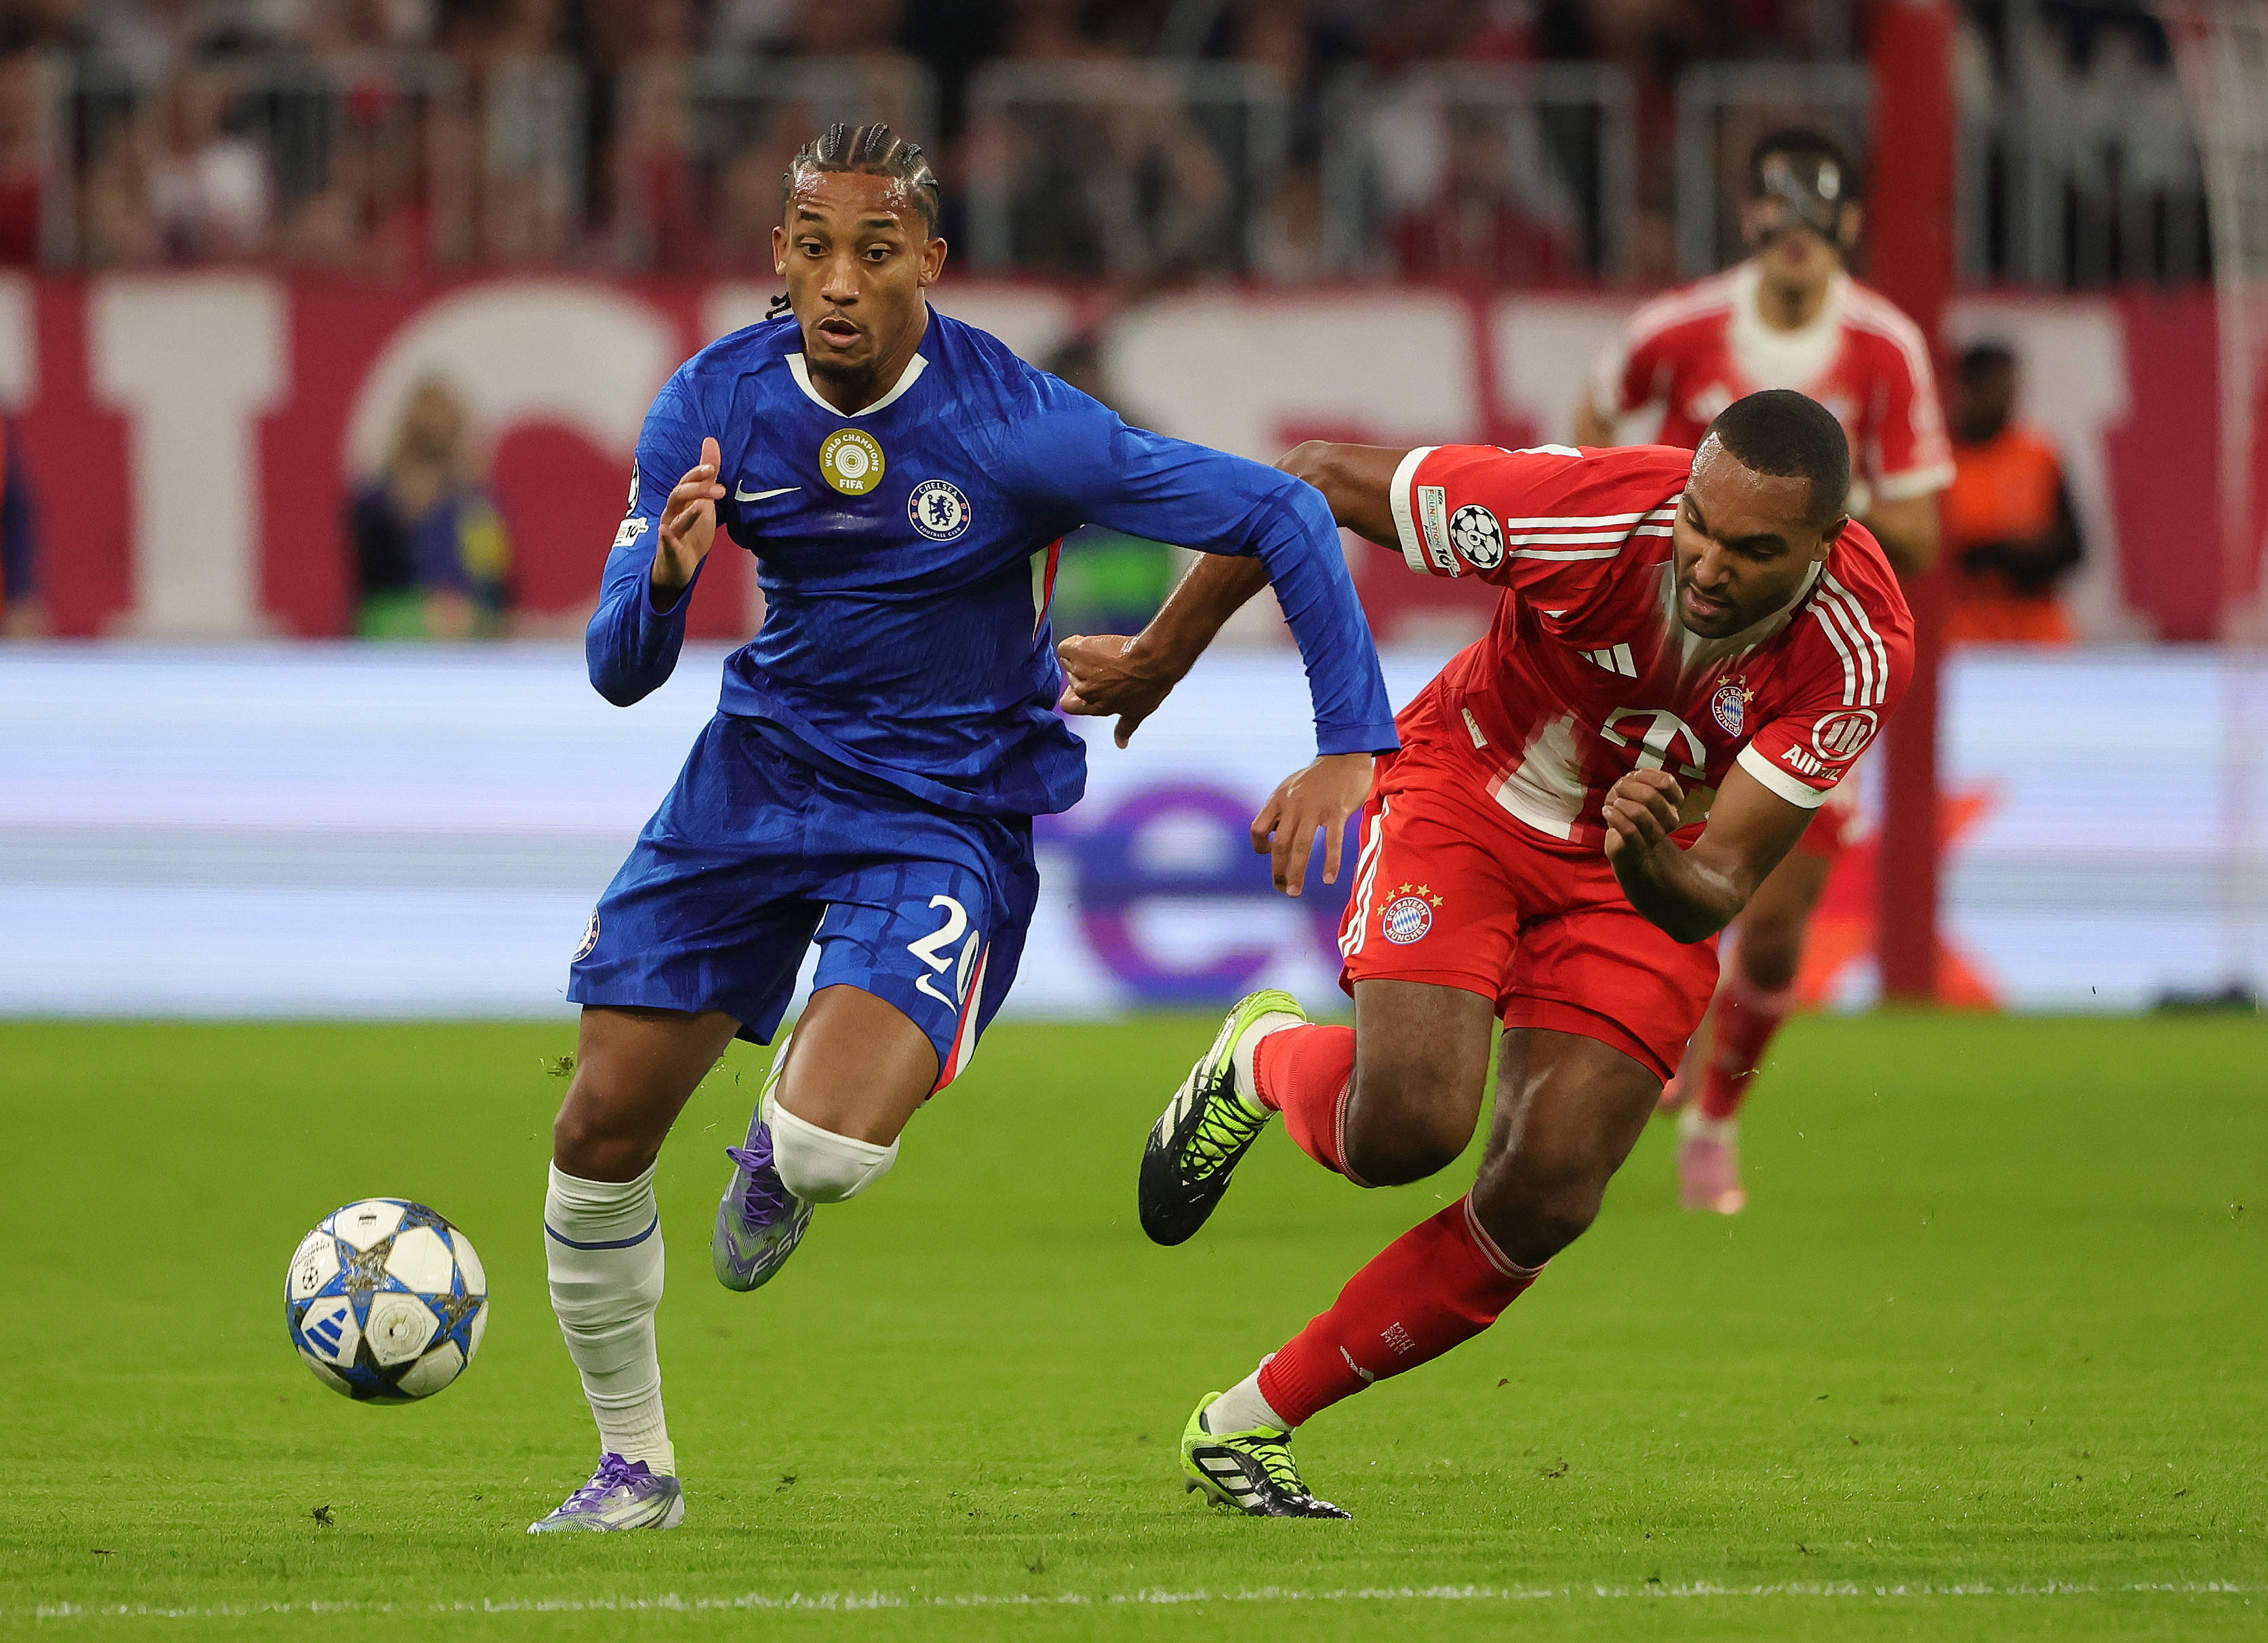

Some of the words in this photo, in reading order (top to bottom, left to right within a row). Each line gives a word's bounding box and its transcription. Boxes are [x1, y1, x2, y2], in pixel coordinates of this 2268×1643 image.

[824, 438, 841, 467] WORLD
[842, 434, 879, 472] CHAMPIONS
[839, 479, 864, 490] FIFA
[919, 482, 957, 497] CHELSEA
[1427, 489, 1442, 547] FOUNDATION
[1718, 690, 1729, 700] FC
[1387, 910, 1396, 921] FC
[1395, 900, 1428, 916] BAYERN
[906, 894, 980, 1006] 20
